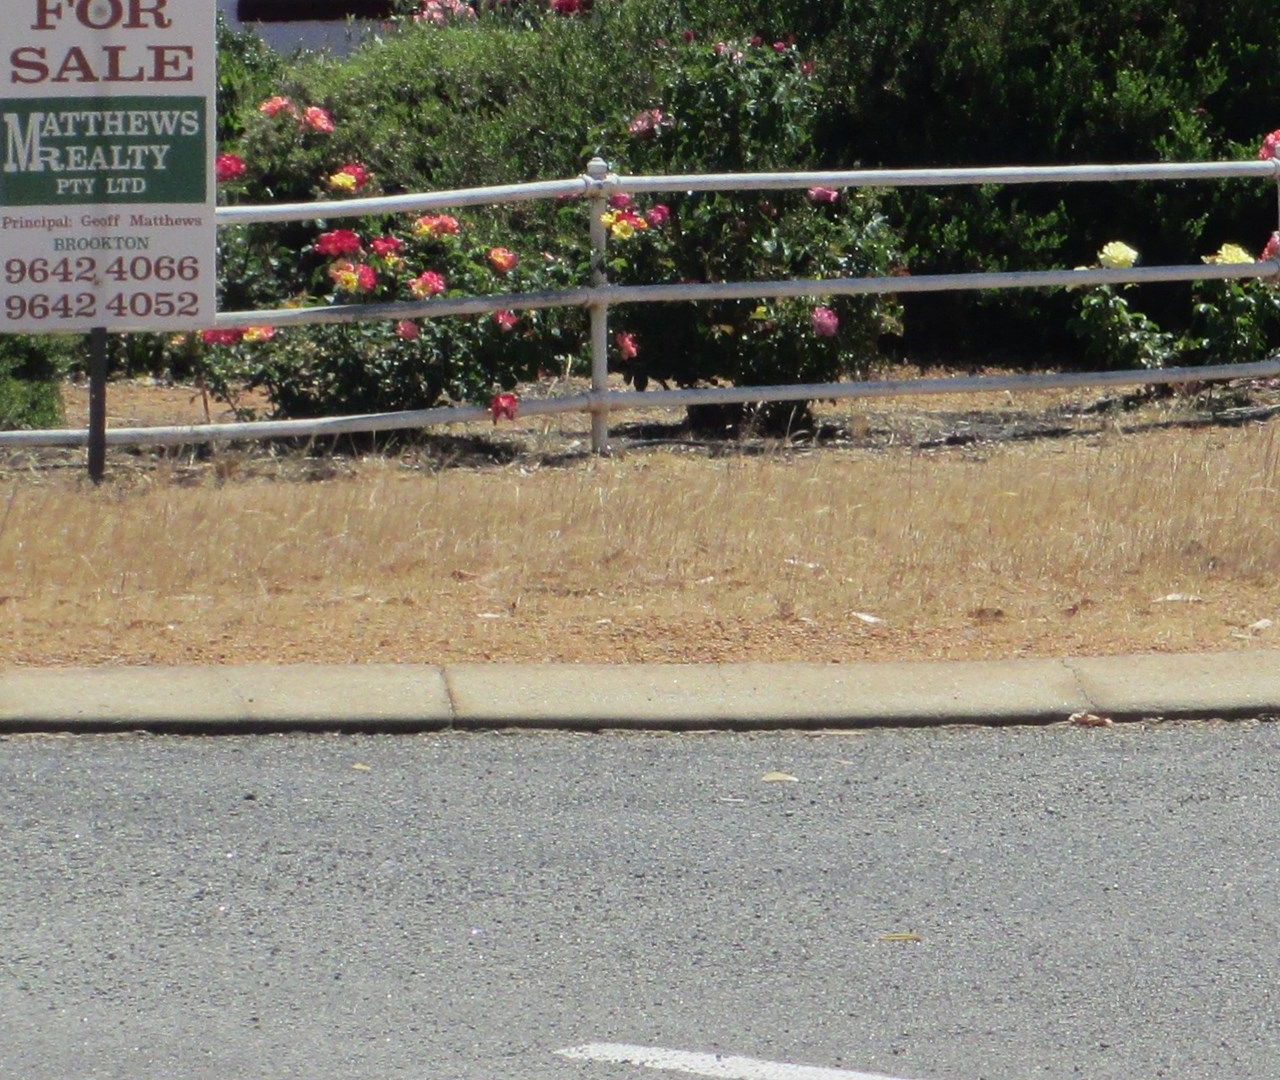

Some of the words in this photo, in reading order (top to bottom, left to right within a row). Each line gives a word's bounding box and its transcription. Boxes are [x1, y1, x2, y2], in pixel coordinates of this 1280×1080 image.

[10, 45, 194, 83] SALE
[3, 110, 200, 172] MATTHEWS
[38, 144, 171, 172] REALTY
[56, 178, 96, 195] PTY
[106, 177, 147, 194] LTD
[81, 214, 120, 227] Geoff
[130, 214, 203, 227] Matthews
[53, 236, 151, 252] BROOKTON
[4, 257, 97, 284] 9642
[106, 255, 200, 281] 4066
[4, 294, 97, 319] 9642
[106, 291, 200, 317] 4052
